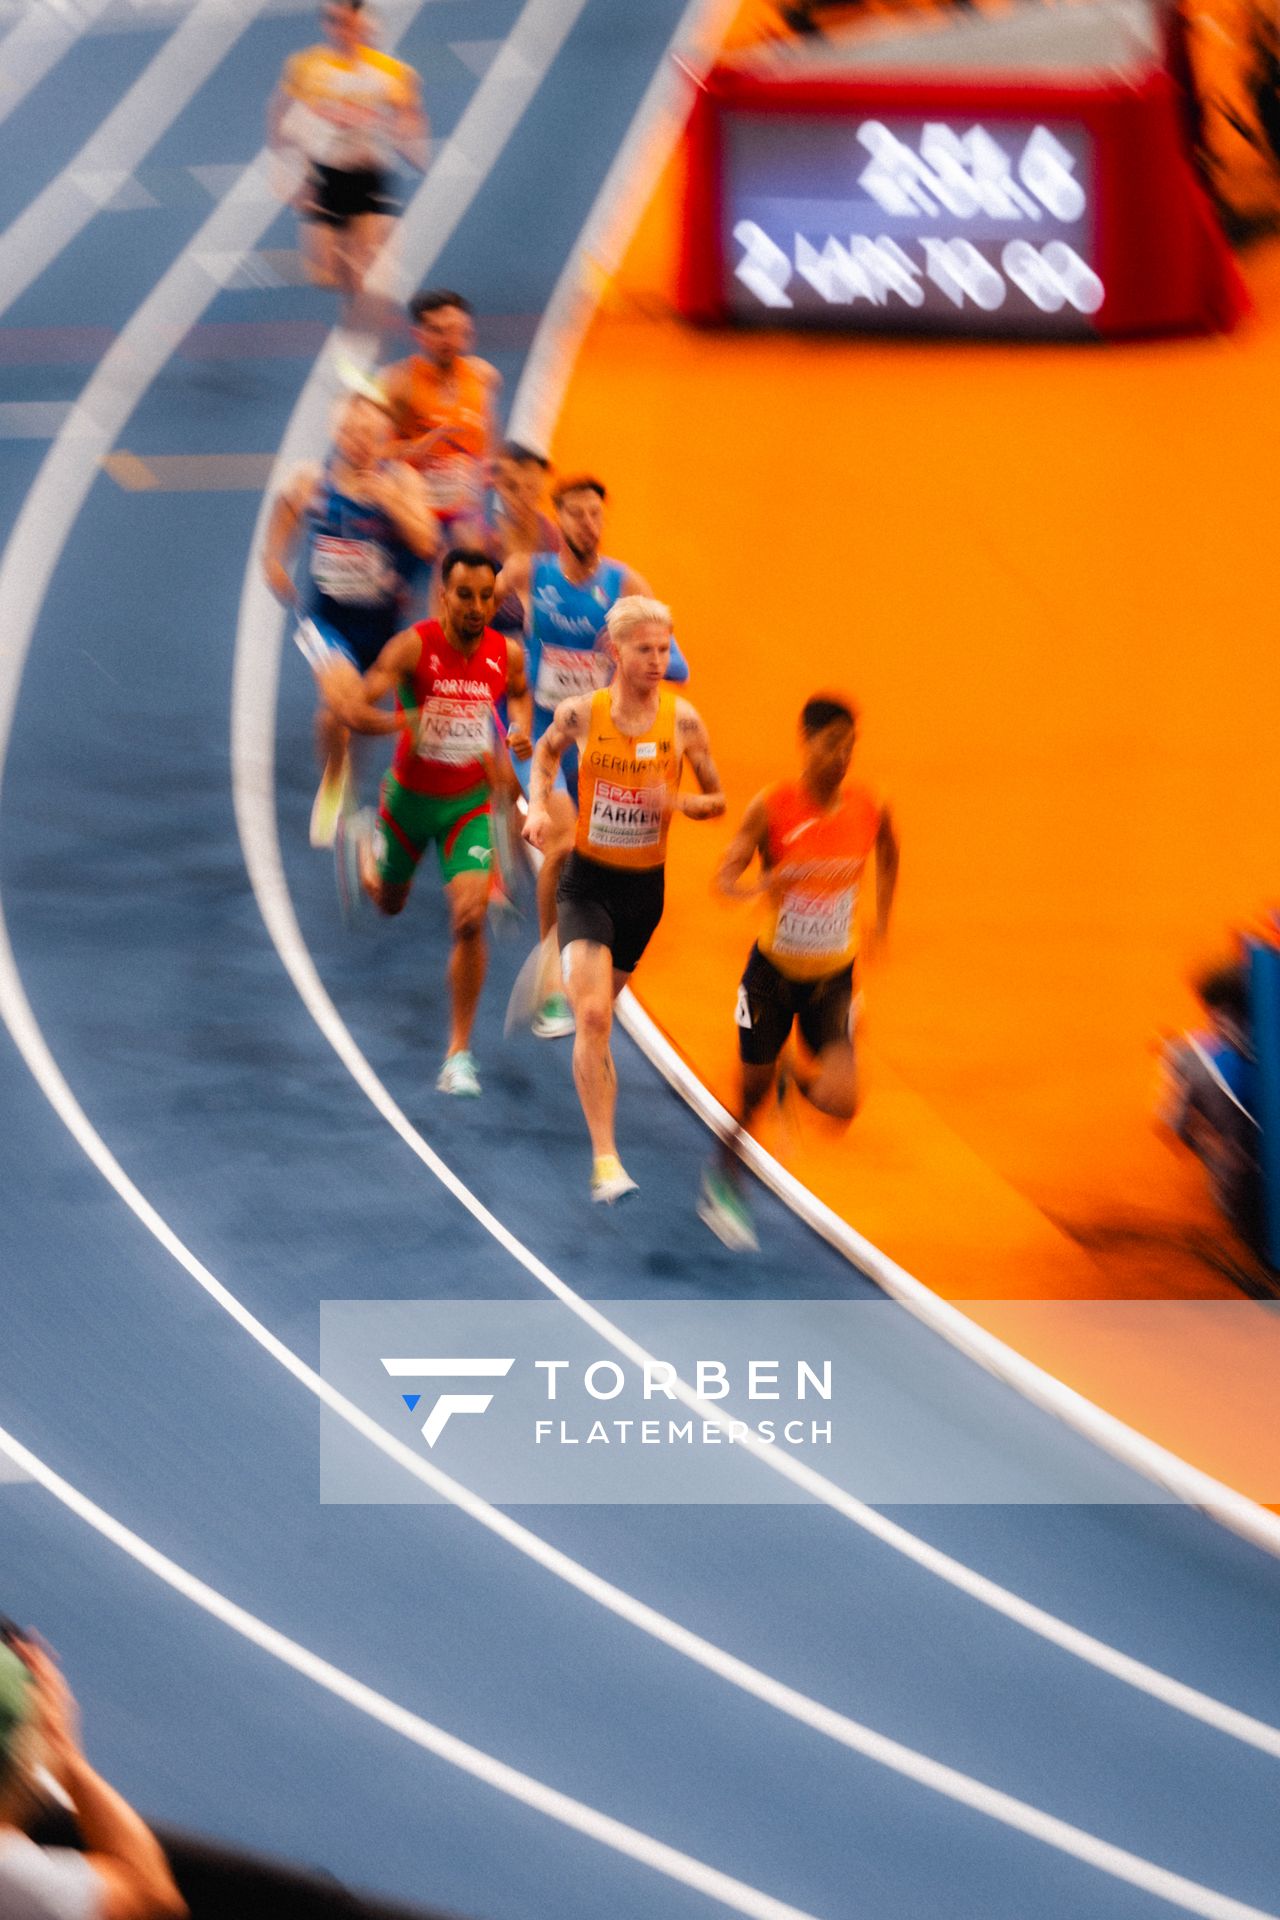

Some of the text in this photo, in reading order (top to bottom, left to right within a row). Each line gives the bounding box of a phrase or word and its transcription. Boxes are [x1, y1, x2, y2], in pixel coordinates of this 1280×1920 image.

[433, 679, 493, 700] PORTUGAL
[425, 717, 486, 739] NADER
[590, 751, 669, 774] GERMANY
[593, 801, 661, 824] FARKEN
